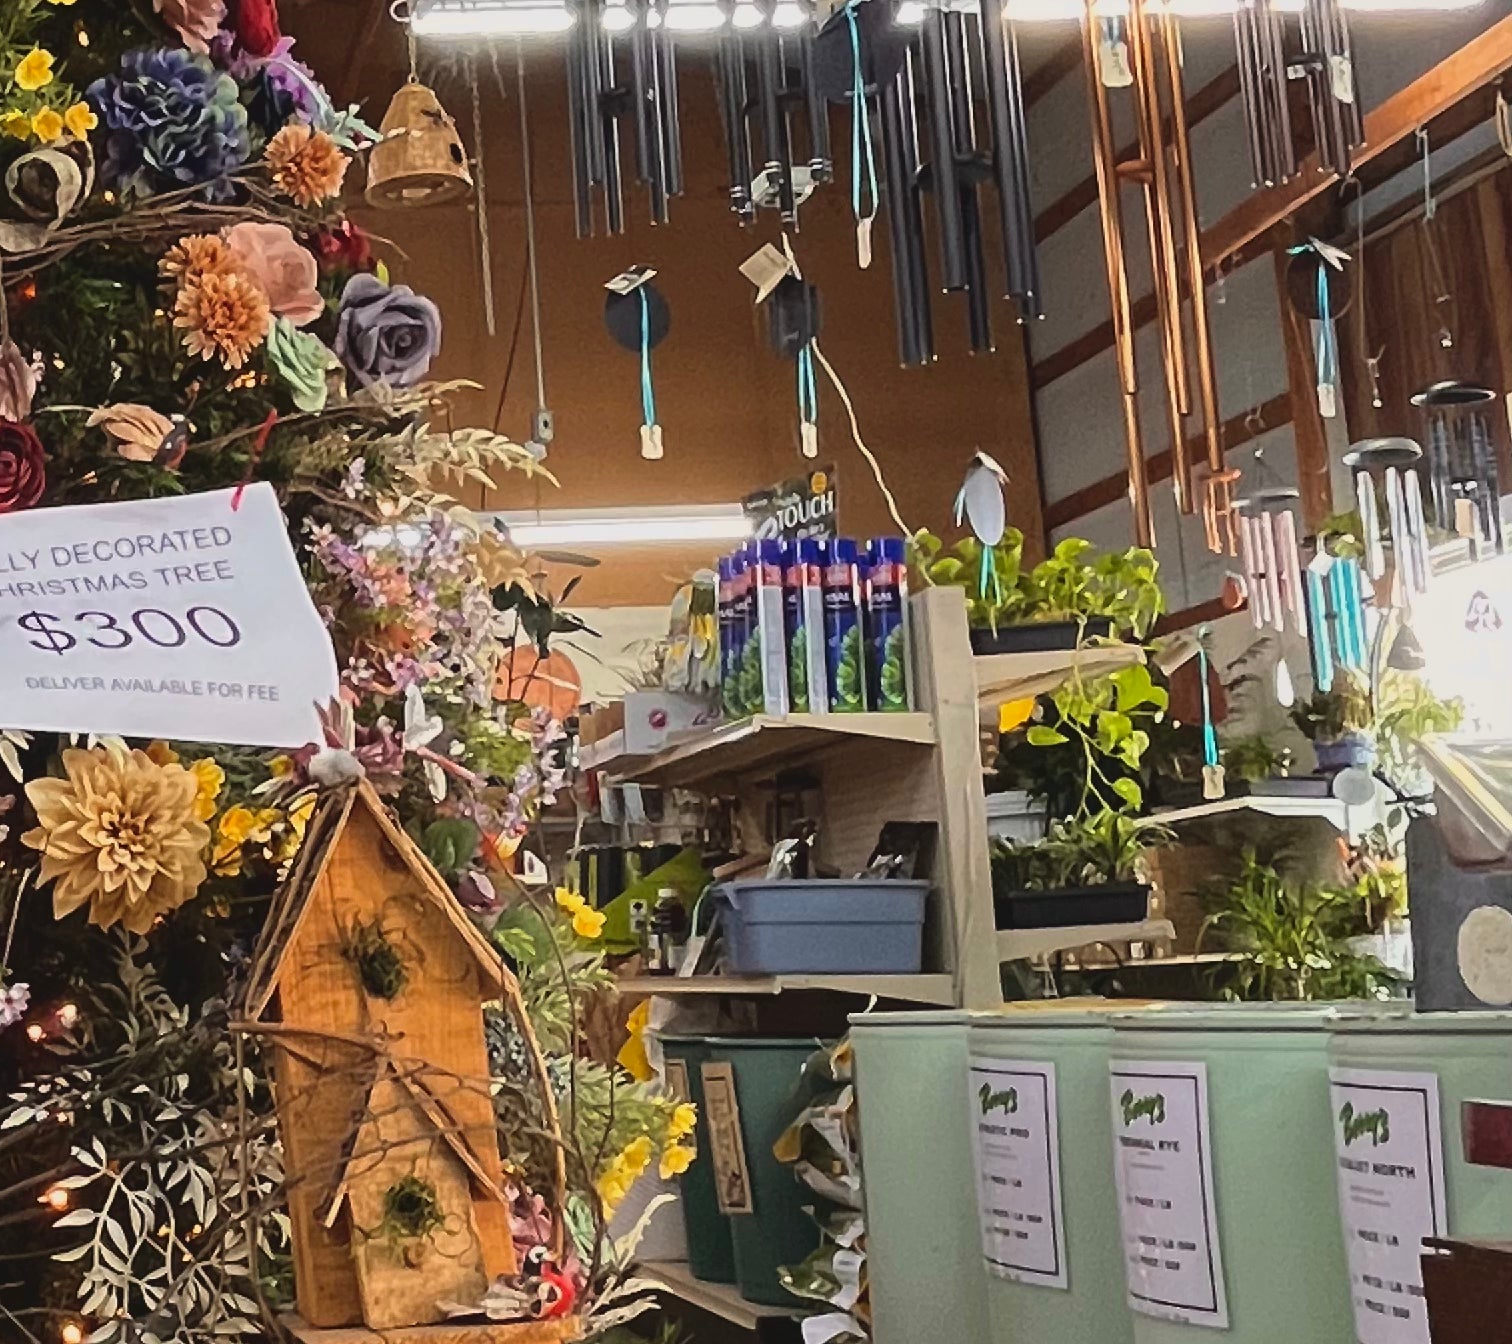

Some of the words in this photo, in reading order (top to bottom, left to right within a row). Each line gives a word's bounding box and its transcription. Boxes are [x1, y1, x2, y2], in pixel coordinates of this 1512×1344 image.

[776, 490, 834, 531] TOUCH
[50, 526, 233, 568] DECORATED
[153, 559, 235, 587] TREE
[17, 606, 241, 656] $300
[25, 676, 106, 691] DELIVER
[110, 678, 204, 696] AVAILABLE
[207, 682, 244, 700] FOR
[248, 684, 280, 702] FEE
